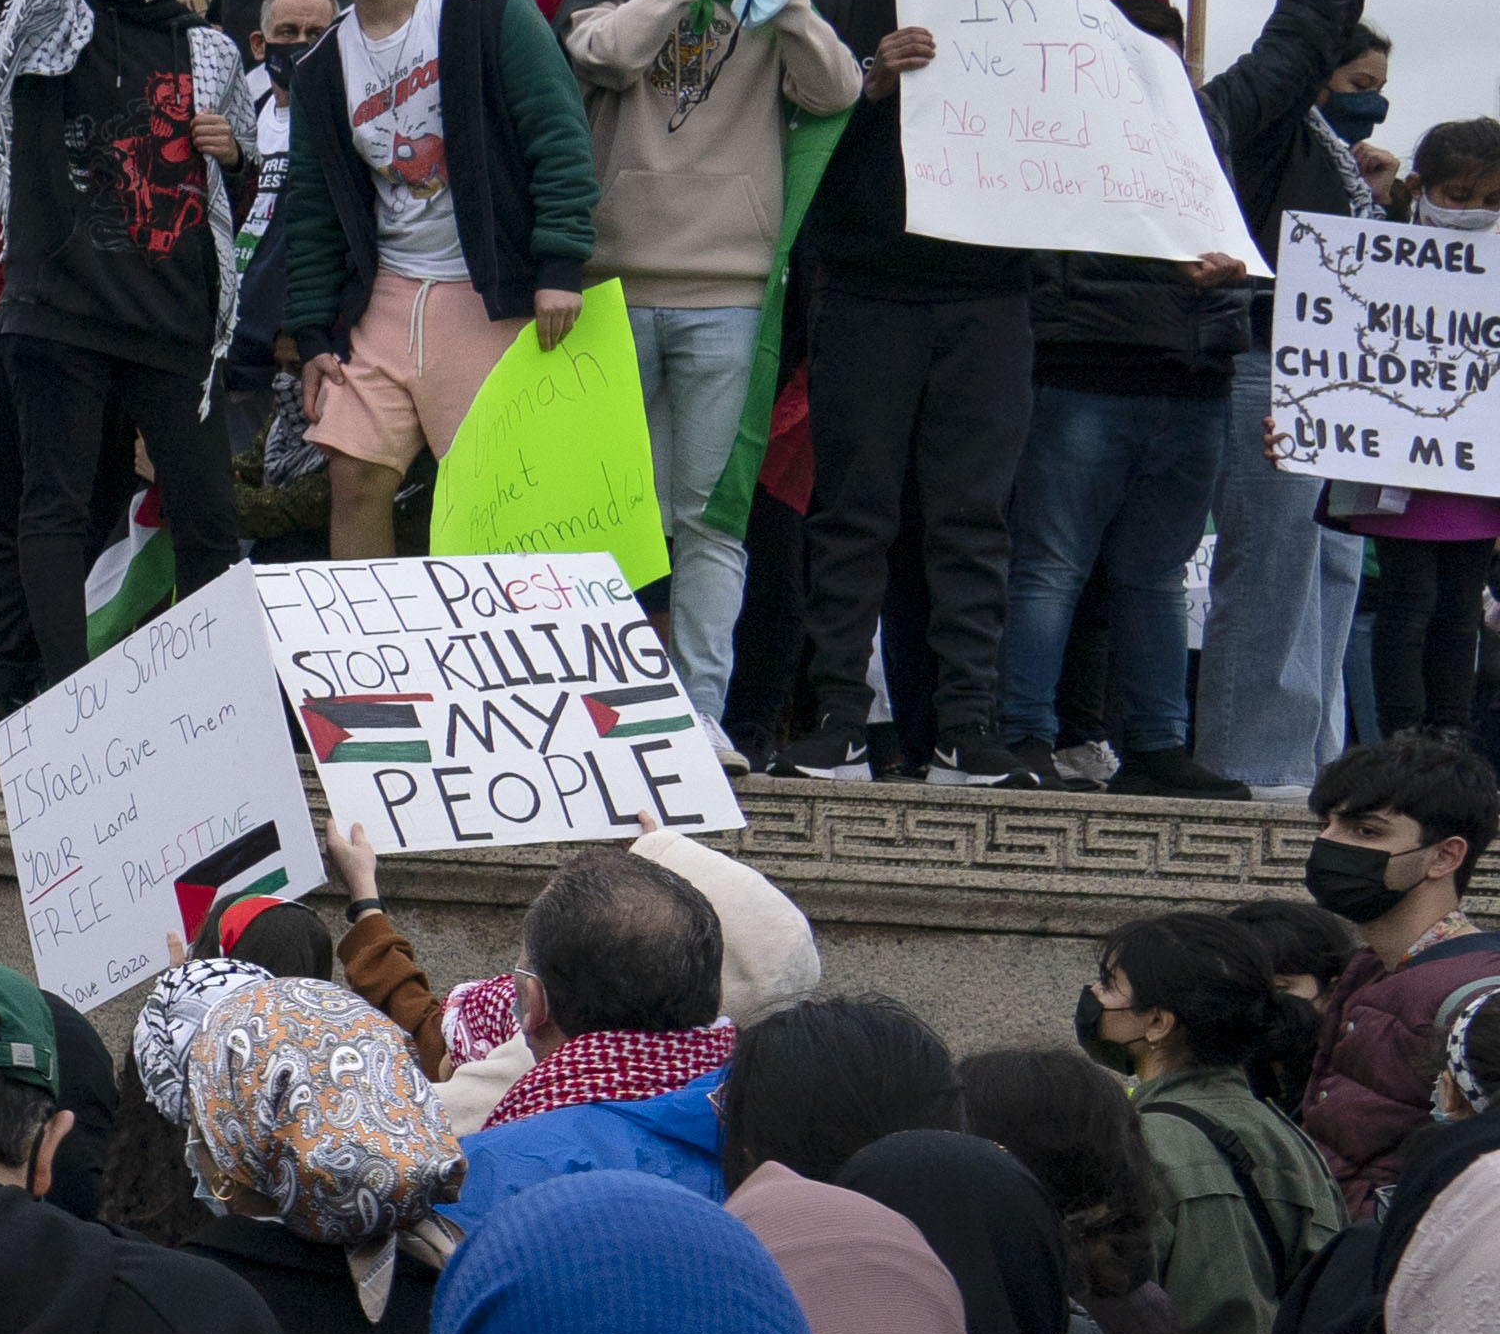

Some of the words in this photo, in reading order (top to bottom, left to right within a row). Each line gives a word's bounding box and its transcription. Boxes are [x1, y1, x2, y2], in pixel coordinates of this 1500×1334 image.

[953, 40, 1015, 77] We
[942, 100, 987, 134] No
[1009, 107, 1090, 145] Need
[914, 149, 953, 186] and
[976, 152, 1008, 190] his
[1019, 160, 1090, 196] Older
[1356, 233, 1486, 274] ISRAEL
[1296, 292, 1333, 324] IS
[1367, 301, 1500, 349] KILLING
[1275, 345, 1491, 393] CHILDREN
[1294, 417, 1381, 458] LIKE
[1408, 436, 1476, 471] ME
[255, 563, 442, 642] FREE
[424, 560, 633, 628] Palestine
[292, 643, 410, 702] STOP
[425, 619, 670, 692] KILLING
[105, 737, 156, 779] Give
[170, 702, 237, 746] Them
[446, 691, 570, 758] MY
[373, 739, 704, 848] PEOPLE
[21, 836, 80, 894] YOUR
[94, 793, 139, 845] Land
[28, 875, 113, 956] FREE
[122, 801, 257, 903] PALESTINE
[62, 980, 100, 1010] Save
[107, 953, 150, 985] Gaza
